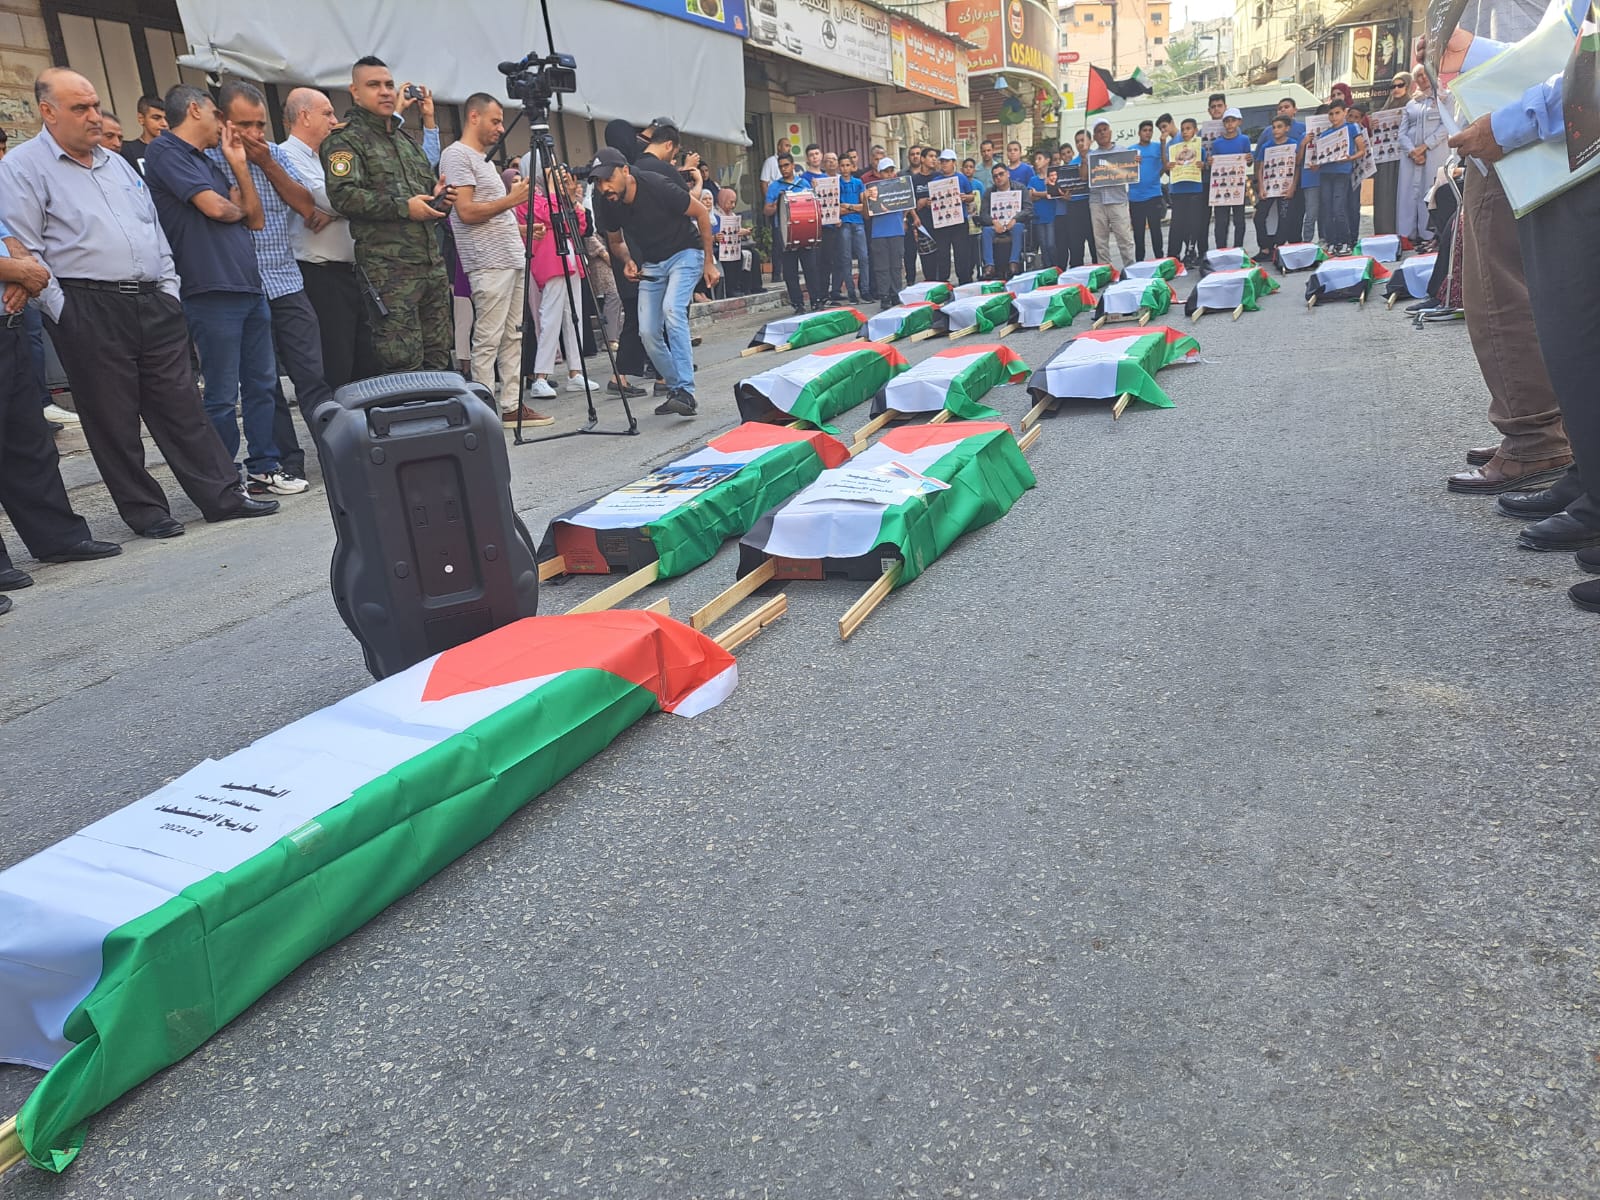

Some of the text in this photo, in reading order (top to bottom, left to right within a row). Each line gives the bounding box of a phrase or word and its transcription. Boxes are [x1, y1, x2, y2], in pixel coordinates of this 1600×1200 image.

[833, 6, 858, 23] كمال
[860, 9, 889, 36] مدرسة
[1011, 41, 1043, 73] OSAMA
[1351, 91, 1370, 99] rince
[1115, 128, 1136, 141] المركز
[220, 782, 291, 799] الشهيد
[216, 817, 259, 833] تاريخ
